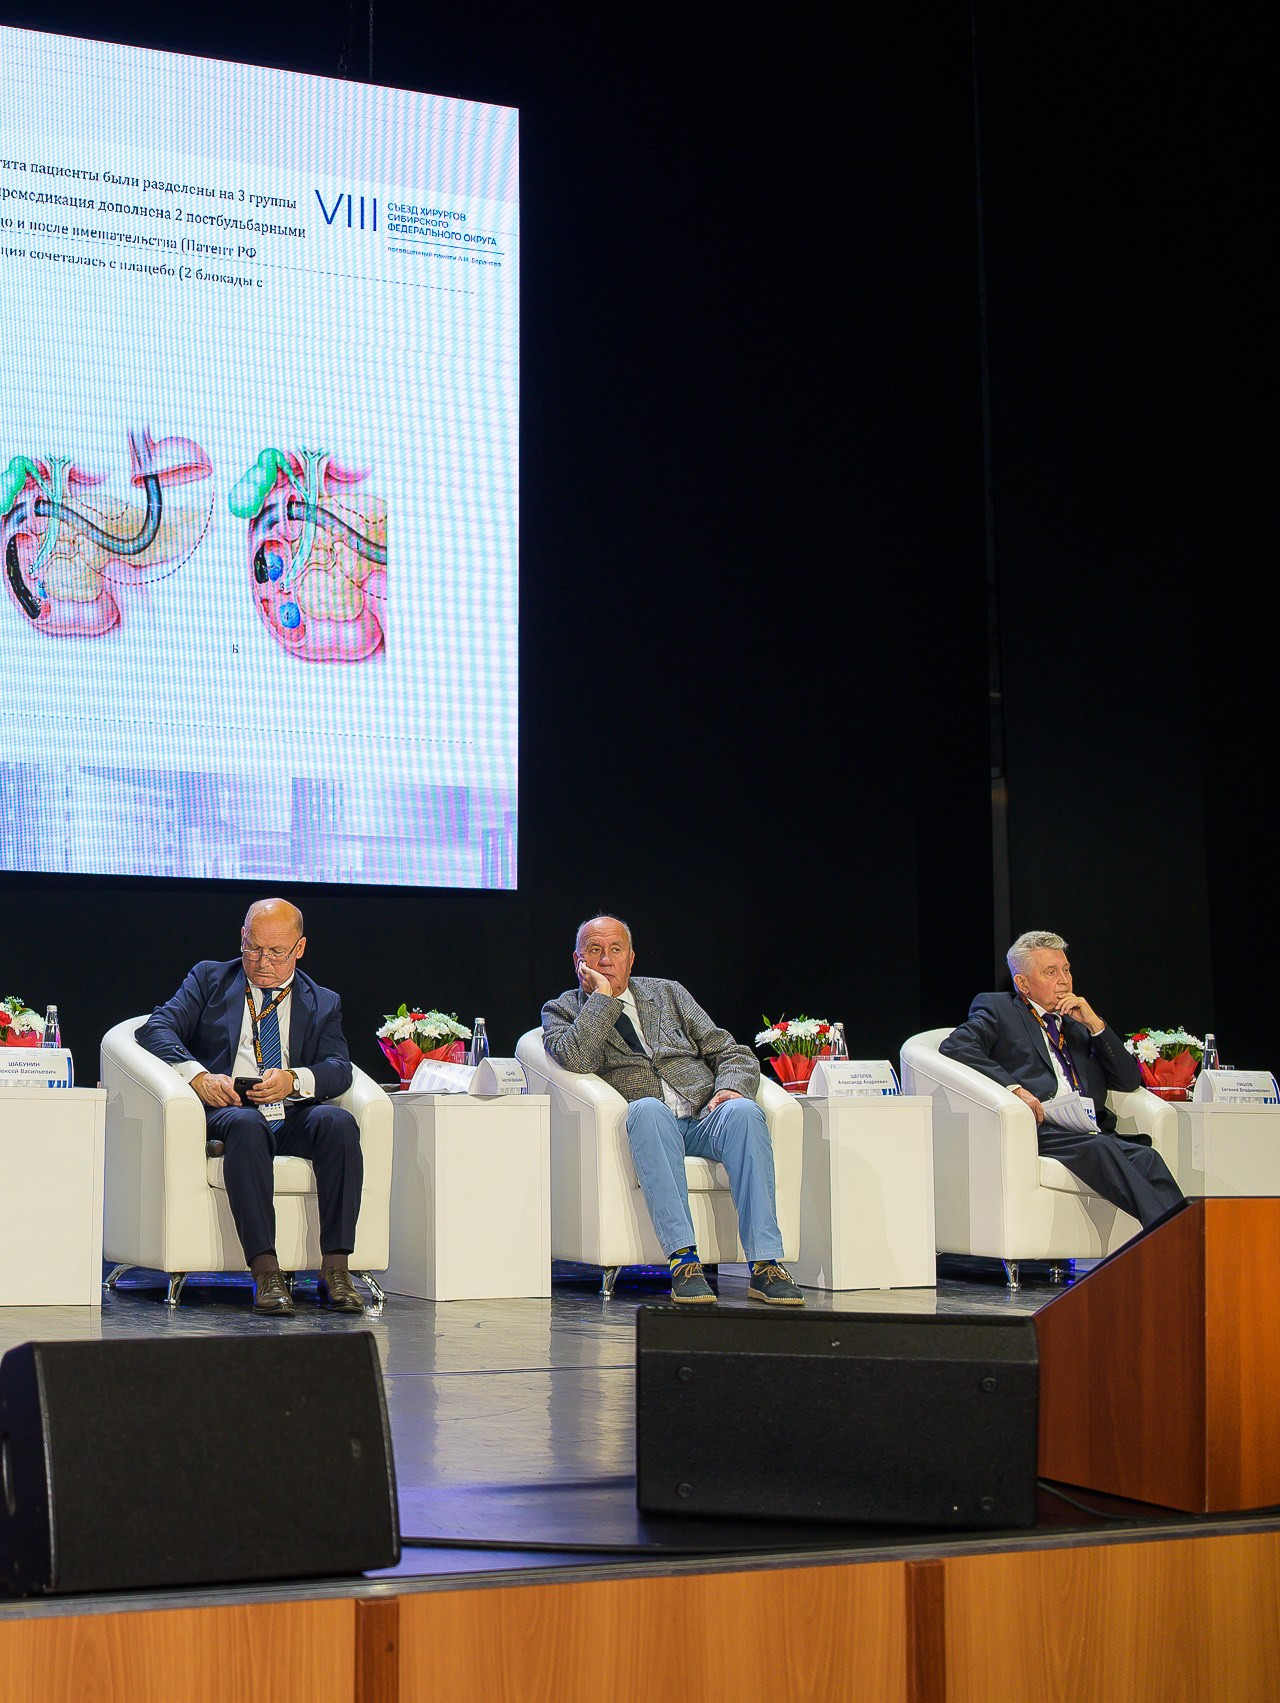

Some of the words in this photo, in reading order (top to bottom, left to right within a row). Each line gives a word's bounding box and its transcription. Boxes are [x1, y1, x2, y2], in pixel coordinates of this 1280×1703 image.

[30, 163, 99, 182] пациенты
[103, 171, 139, 188] были
[143, 178, 215, 199] разделены
[219, 189, 235, 201] на
[238, 189, 245, 202] 3
[249, 193, 297, 210] группы
[98, 200, 172, 220] дополнена
[175, 208, 183, 222] 2
[186, 211, 306, 239] постбульбарными
[314, 189, 377, 232] VIII
[387, 202, 419, 216] СЪЕЗД
[420, 207, 467, 222] ХИРУРГОВ
[387, 213, 449, 229] СИБИРСКОГО
[17, 219, 25, 229] и
[29, 221, 69, 235] после
[72, 225, 177, 249] вмешательства
[180, 237, 234, 257] (Патент
[237, 245, 257, 258] РФ
[387, 222, 462, 241] ФЕДЕРАЛЬНОГО
[463, 233, 497, 246] ОКРУГА
[29, 250, 106, 268] сочеталась
[109, 260, 117, 269] с
[120, 262, 175, 277] плацебо
[178, 265, 192, 281] (2
[195, 268, 253, 287] блокады
[256, 279, 263, 288] с
